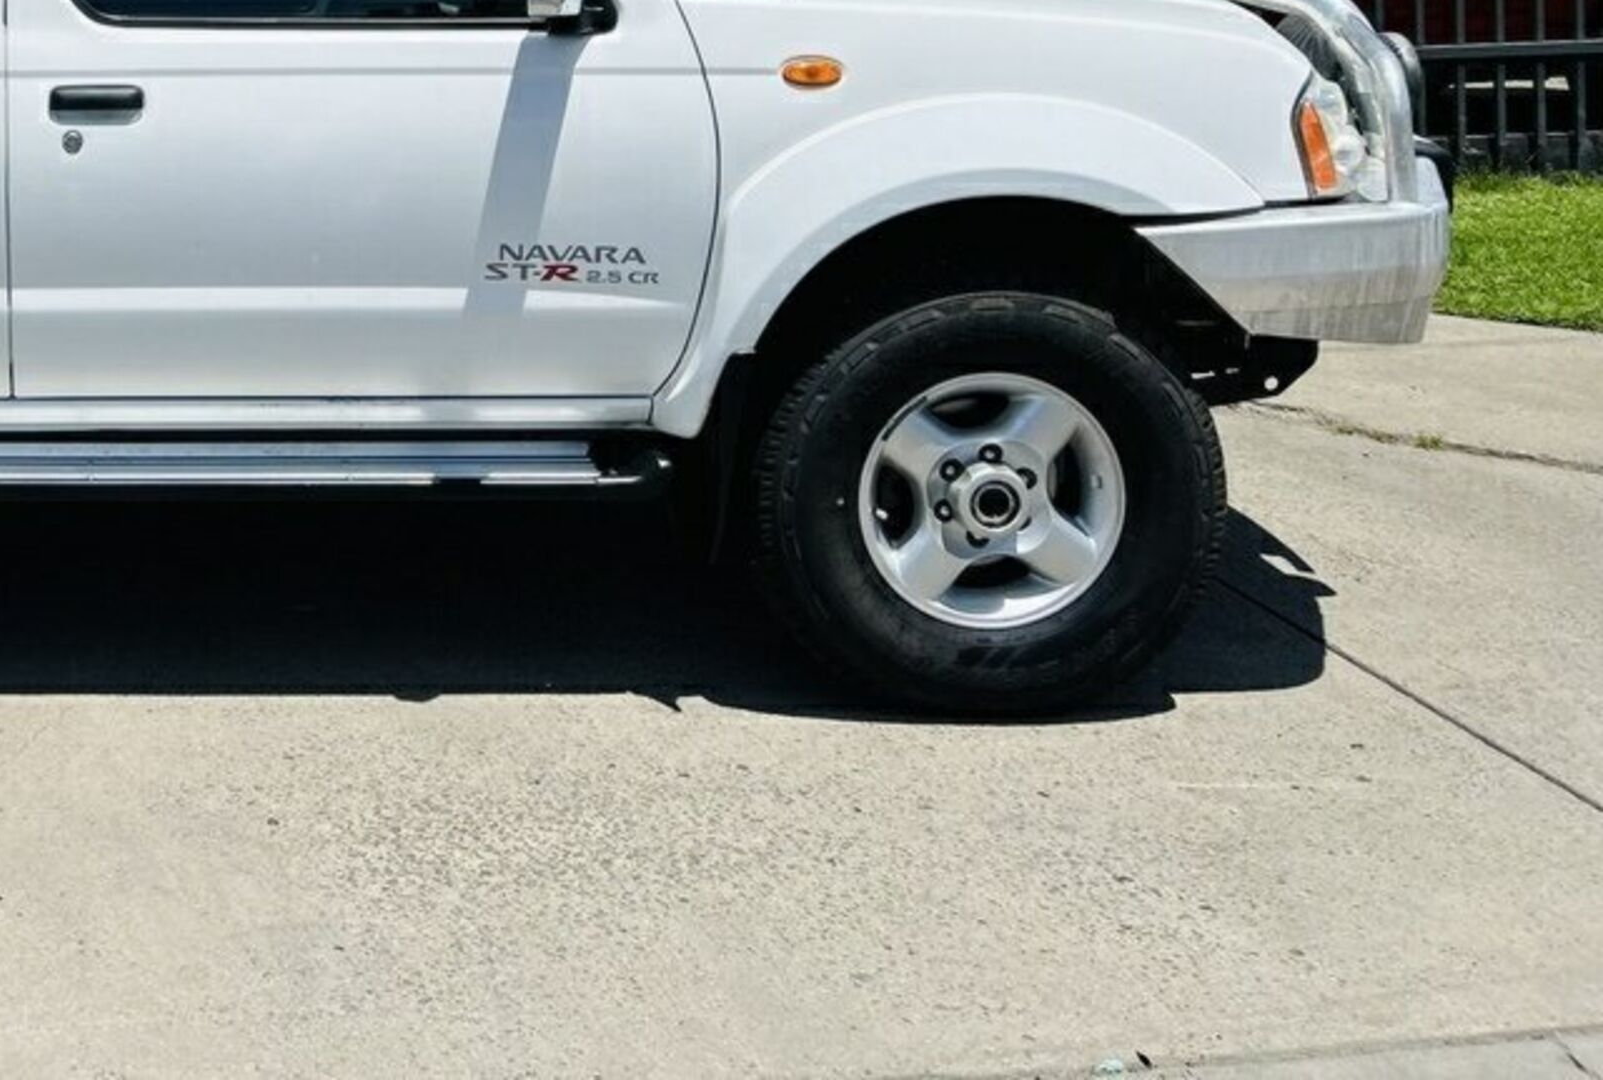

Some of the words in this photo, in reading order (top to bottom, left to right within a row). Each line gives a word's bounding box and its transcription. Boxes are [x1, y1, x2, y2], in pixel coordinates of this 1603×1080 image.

[499, 244, 646, 264] NAVARA
[485, 263, 580, 282] ST-R
[586, 270, 622, 284] 2.5
[628, 272, 659, 284] CR
